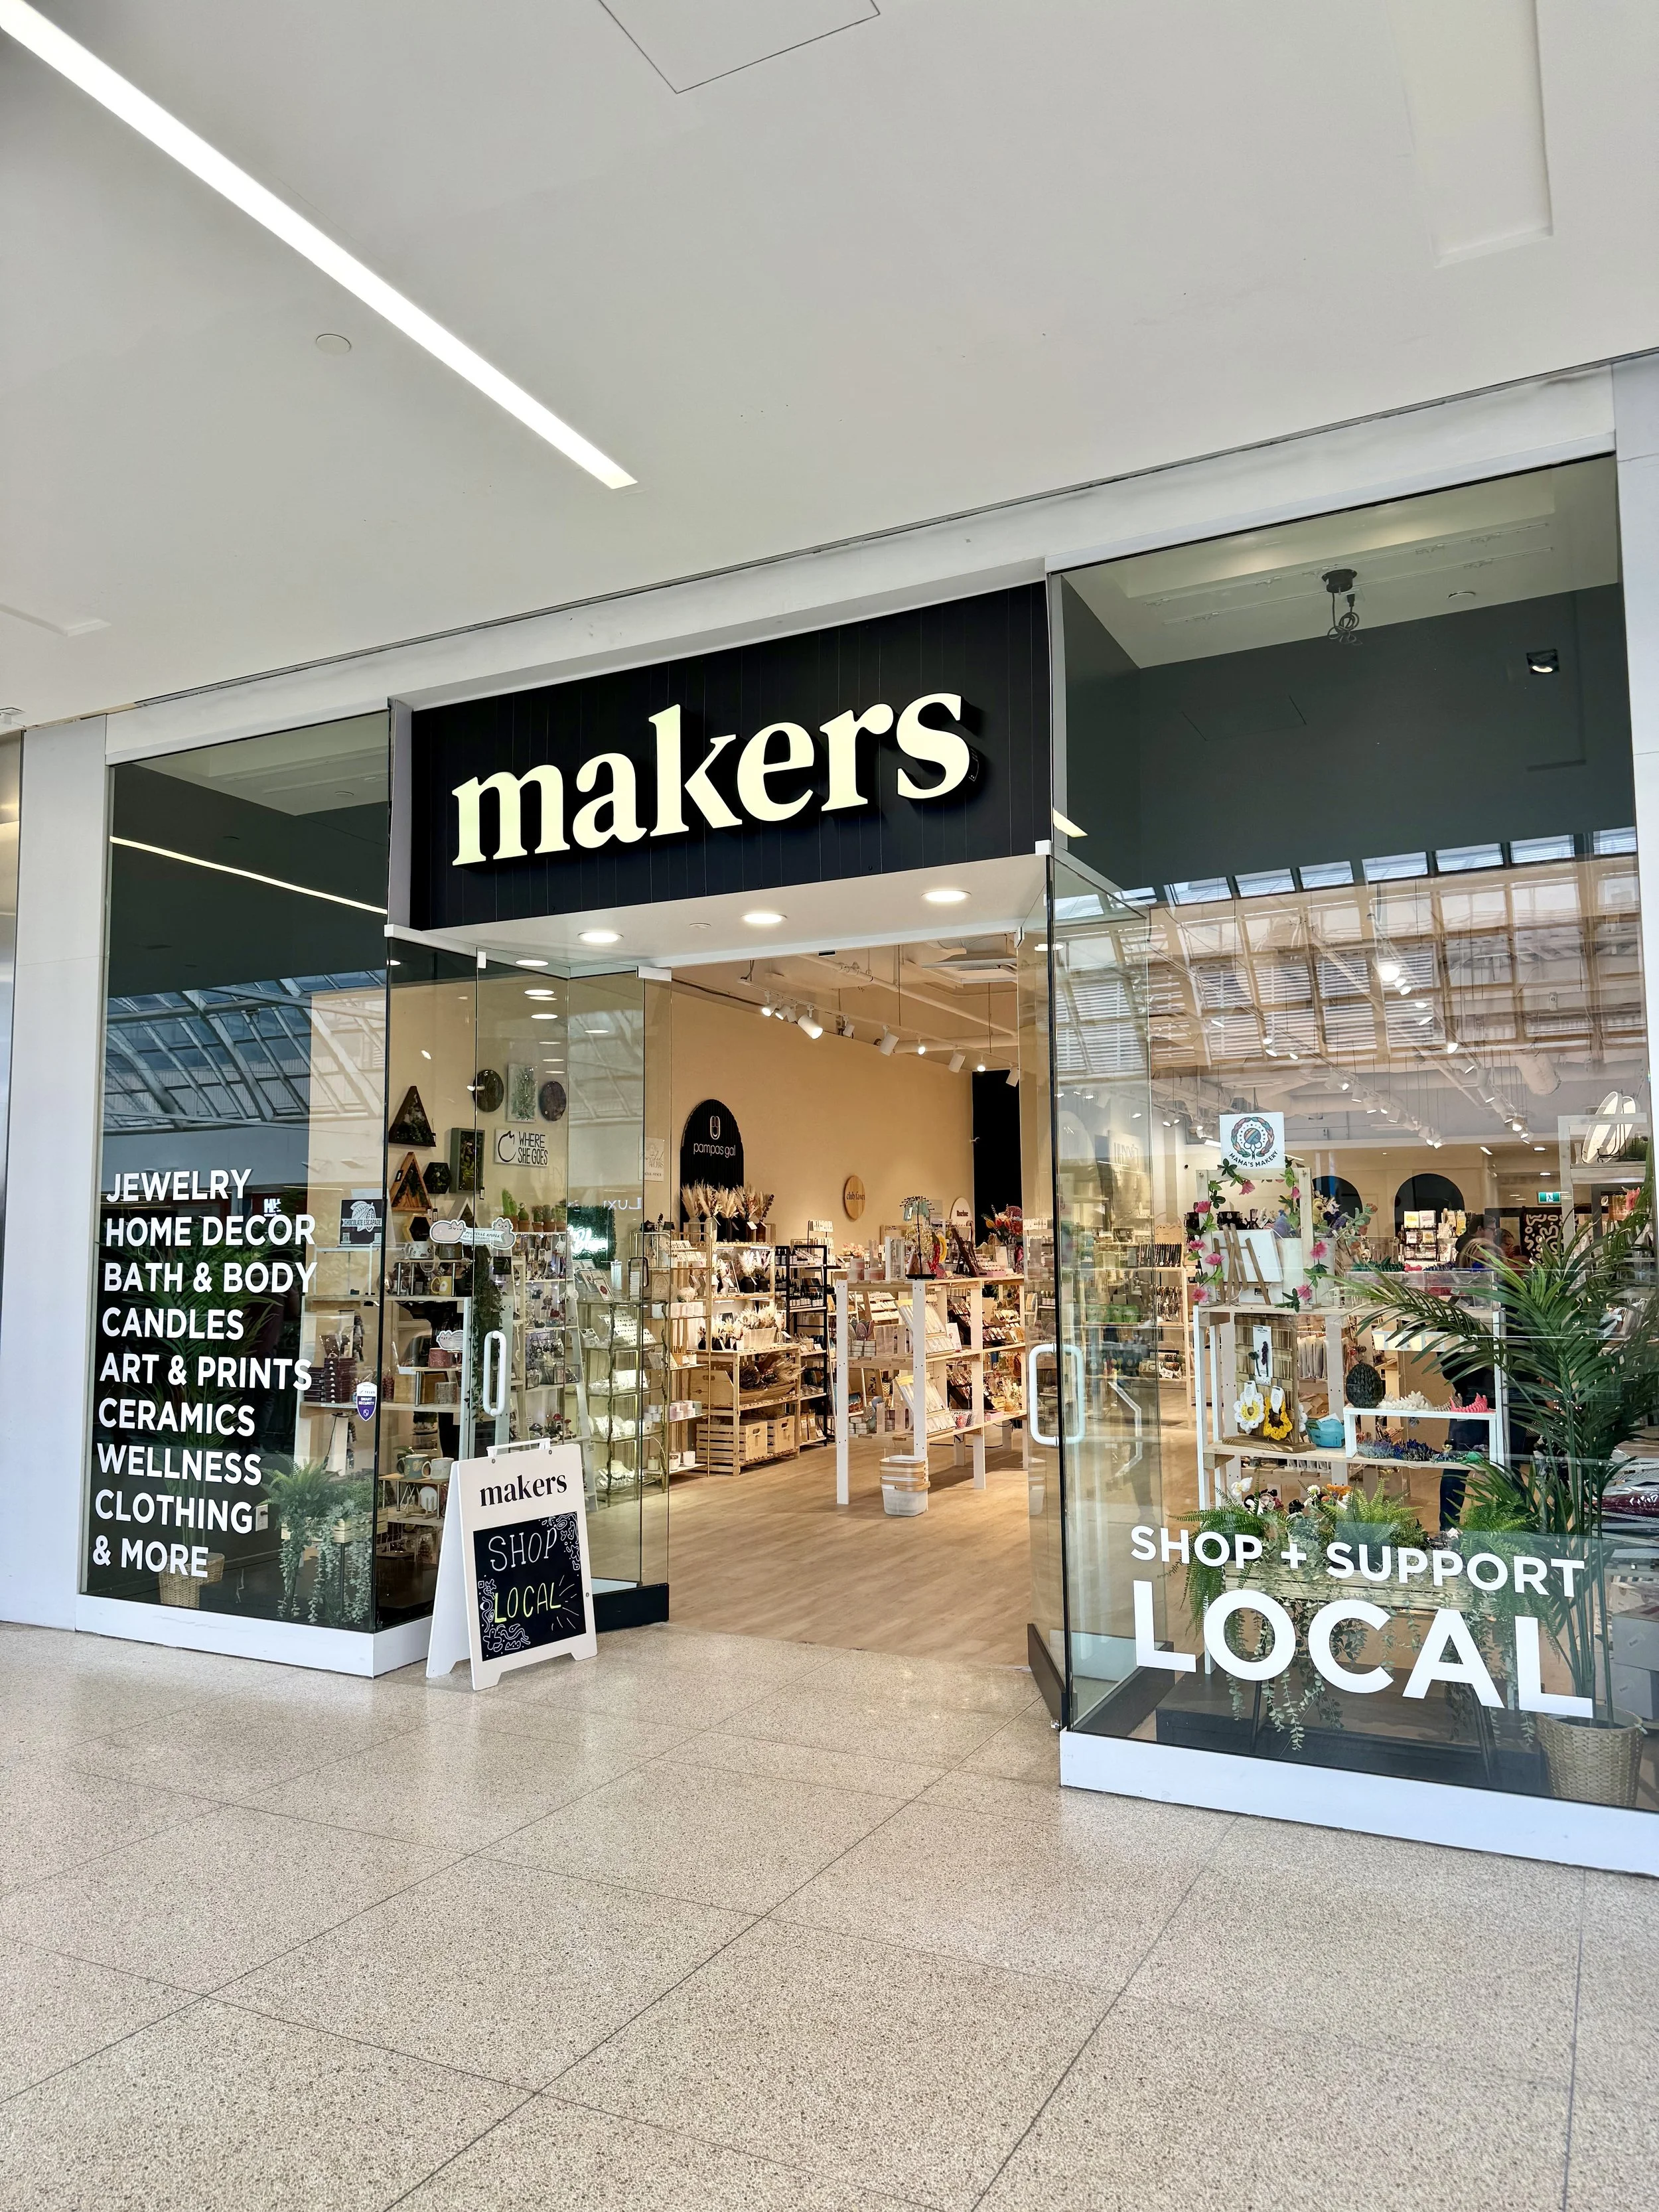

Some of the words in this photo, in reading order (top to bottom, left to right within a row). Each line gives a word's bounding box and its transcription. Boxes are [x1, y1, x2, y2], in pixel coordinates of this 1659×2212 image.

[453, 694, 970, 865] makers
[518, 1131, 545, 1148] WHERE
[518, 1147, 530, 1164] SHE
[532, 1148, 548, 1165] GOES
[693, 1143, 724, 1156] pampas
[725, 1145, 736, 1158] gal
[1229, 1153, 1254, 1167] MAMA'S
[1255, 1150, 1278, 1167] MAKERY
[106, 1169, 252, 1203] JEWELRY
[106, 1217, 192, 1246] HOME
[202, 1213, 315, 1246] DECOR
[364, 1218, 382, 1227] ESCAPADE
[104, 1262, 183, 1292] BATH
[193, 1262, 212, 1293] &
[224, 1262, 318, 1293] BODY
[102, 1307, 244, 1340] CANDLES
[100, 1353, 159, 1384] ART
[168, 1355, 187, 1386] &
[198, 1356, 312, 1391] PRINTS
[99, 1398, 255, 1437] CERAMICS
[97, 1443, 261, 1486] WELLNESS
[480, 1475, 567, 1507] makers
[96, 1489, 252, 1534] CLOTHING
[93, 1535, 111, 1566] &
[121, 1538, 208, 1578] MORE
[488, 1527, 557, 1572] SHOP
[1131, 1525, 1263, 1570] SHOP
[1280, 1543, 1307, 1569] +
[1326, 1541, 1585, 1597] SUPPORT
[494, 1582, 561, 1623] LOCAL
[1133, 1580, 1593, 1718] LOCAL
